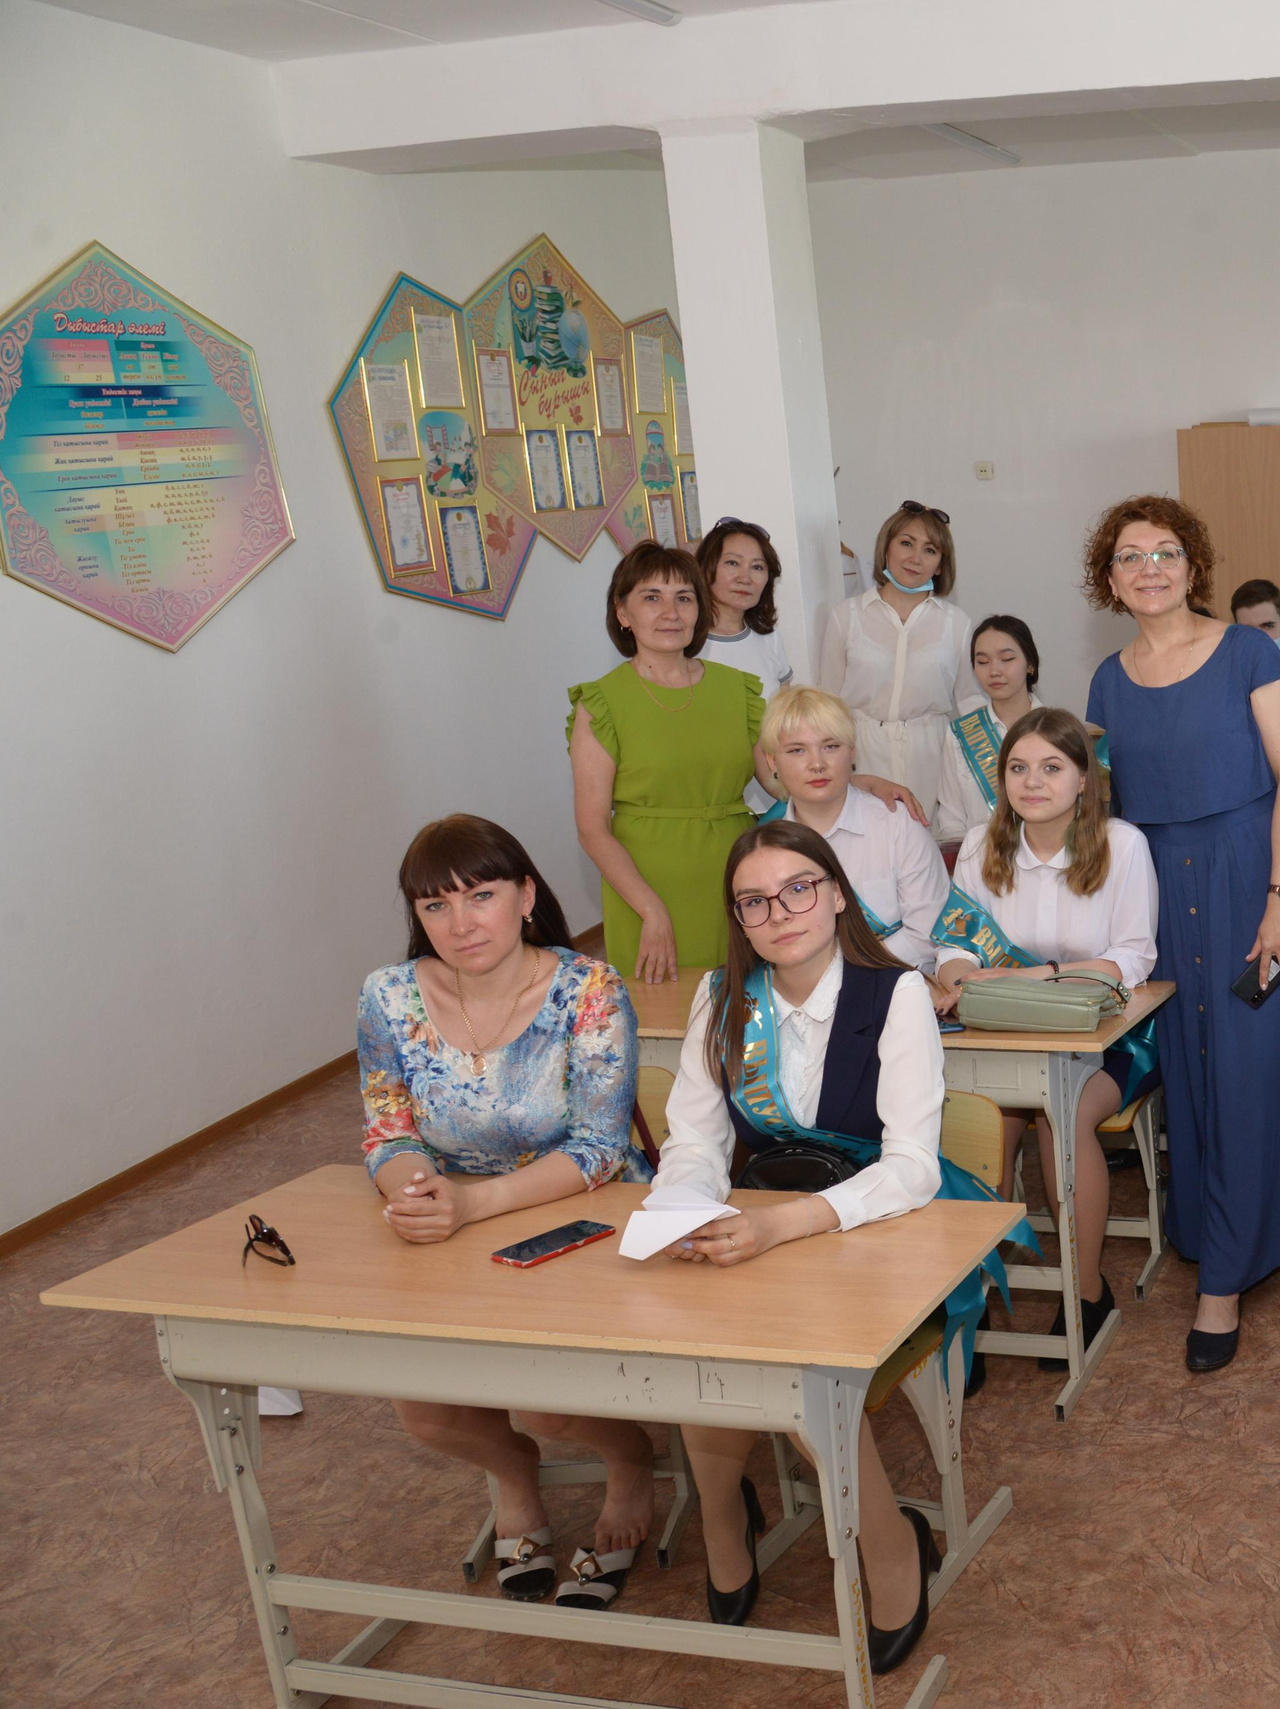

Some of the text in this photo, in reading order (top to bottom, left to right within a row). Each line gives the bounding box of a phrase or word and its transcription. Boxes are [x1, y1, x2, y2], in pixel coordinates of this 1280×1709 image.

[53, 312, 166, 339] Дыбыстар әлемі
[519, 369, 566, 406] Сынып
